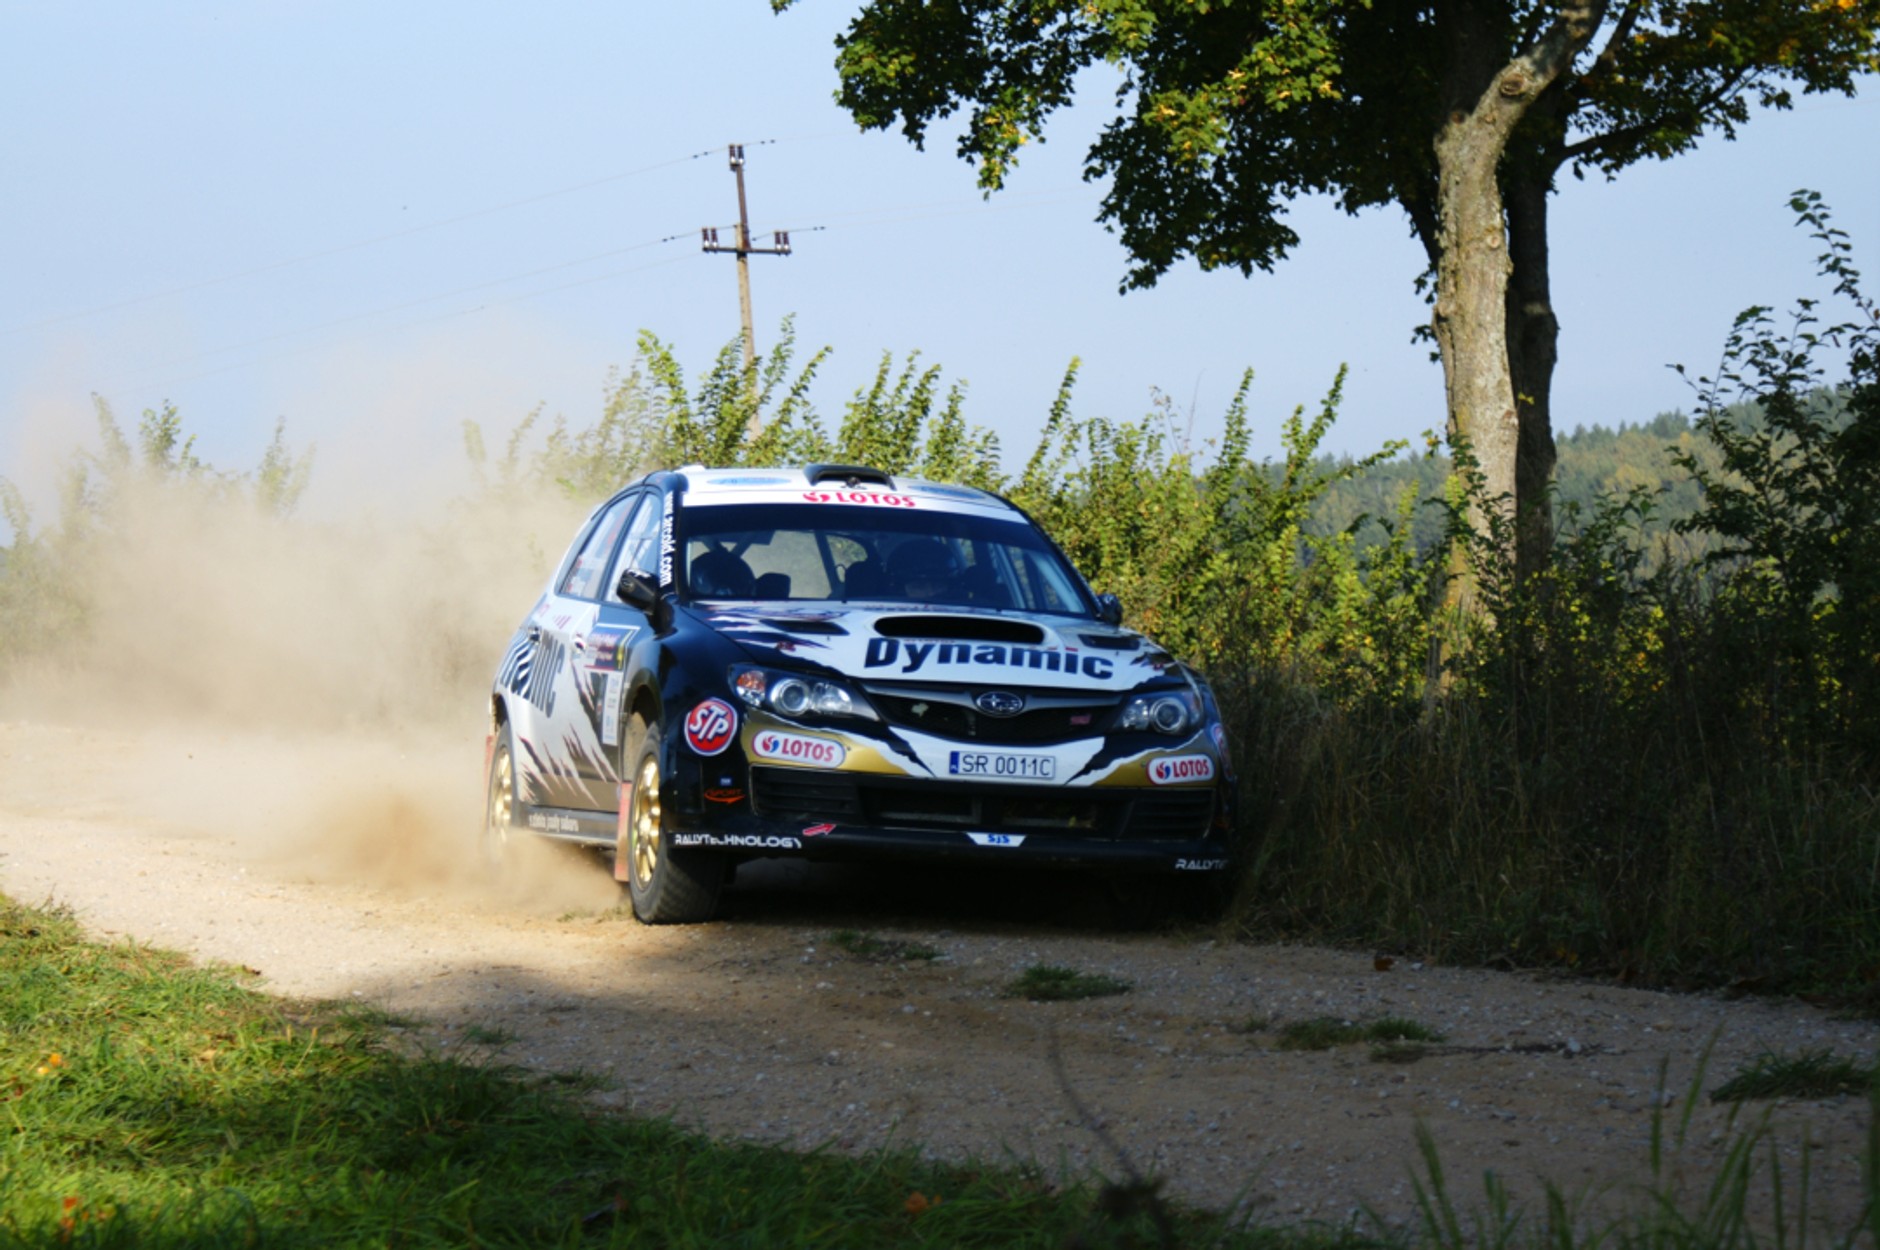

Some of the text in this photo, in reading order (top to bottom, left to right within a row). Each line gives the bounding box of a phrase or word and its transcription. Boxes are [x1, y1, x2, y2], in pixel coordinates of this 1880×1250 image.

[835, 491, 916, 508] LOTOS
[864, 637, 1114, 680] Dynamic
[689, 704, 730, 742] STP
[781, 738, 835, 762] LOTOS
[961, 754, 988, 773] SR
[995, 756, 1051, 776] 0011C
[1172, 759, 1210, 777] LOTOS
